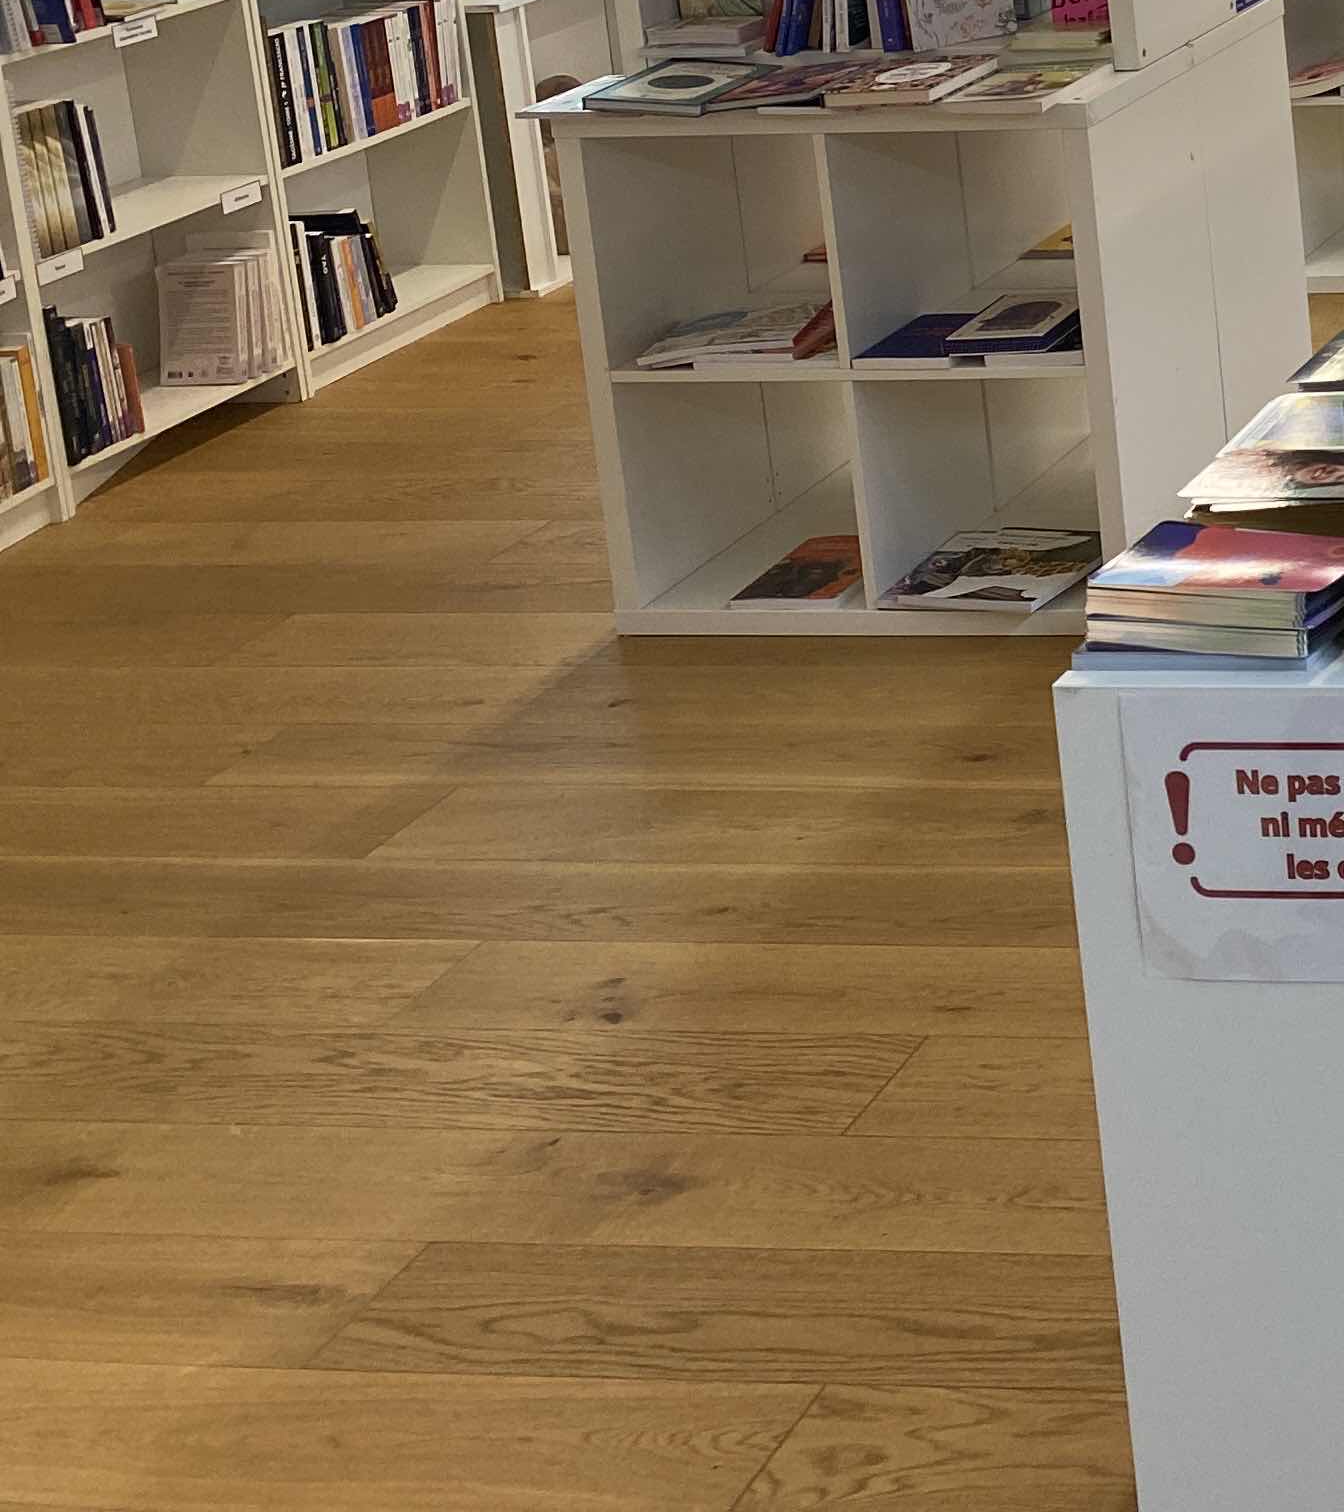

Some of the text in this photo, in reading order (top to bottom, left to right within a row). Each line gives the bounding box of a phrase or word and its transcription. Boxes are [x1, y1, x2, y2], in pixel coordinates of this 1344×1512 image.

[1235, 769, 1279, 796] Ne
[1287, 774, 1341, 802] pas
[1260, 811, 1290, 838] ni
[1286, 853, 1331, 880] les
